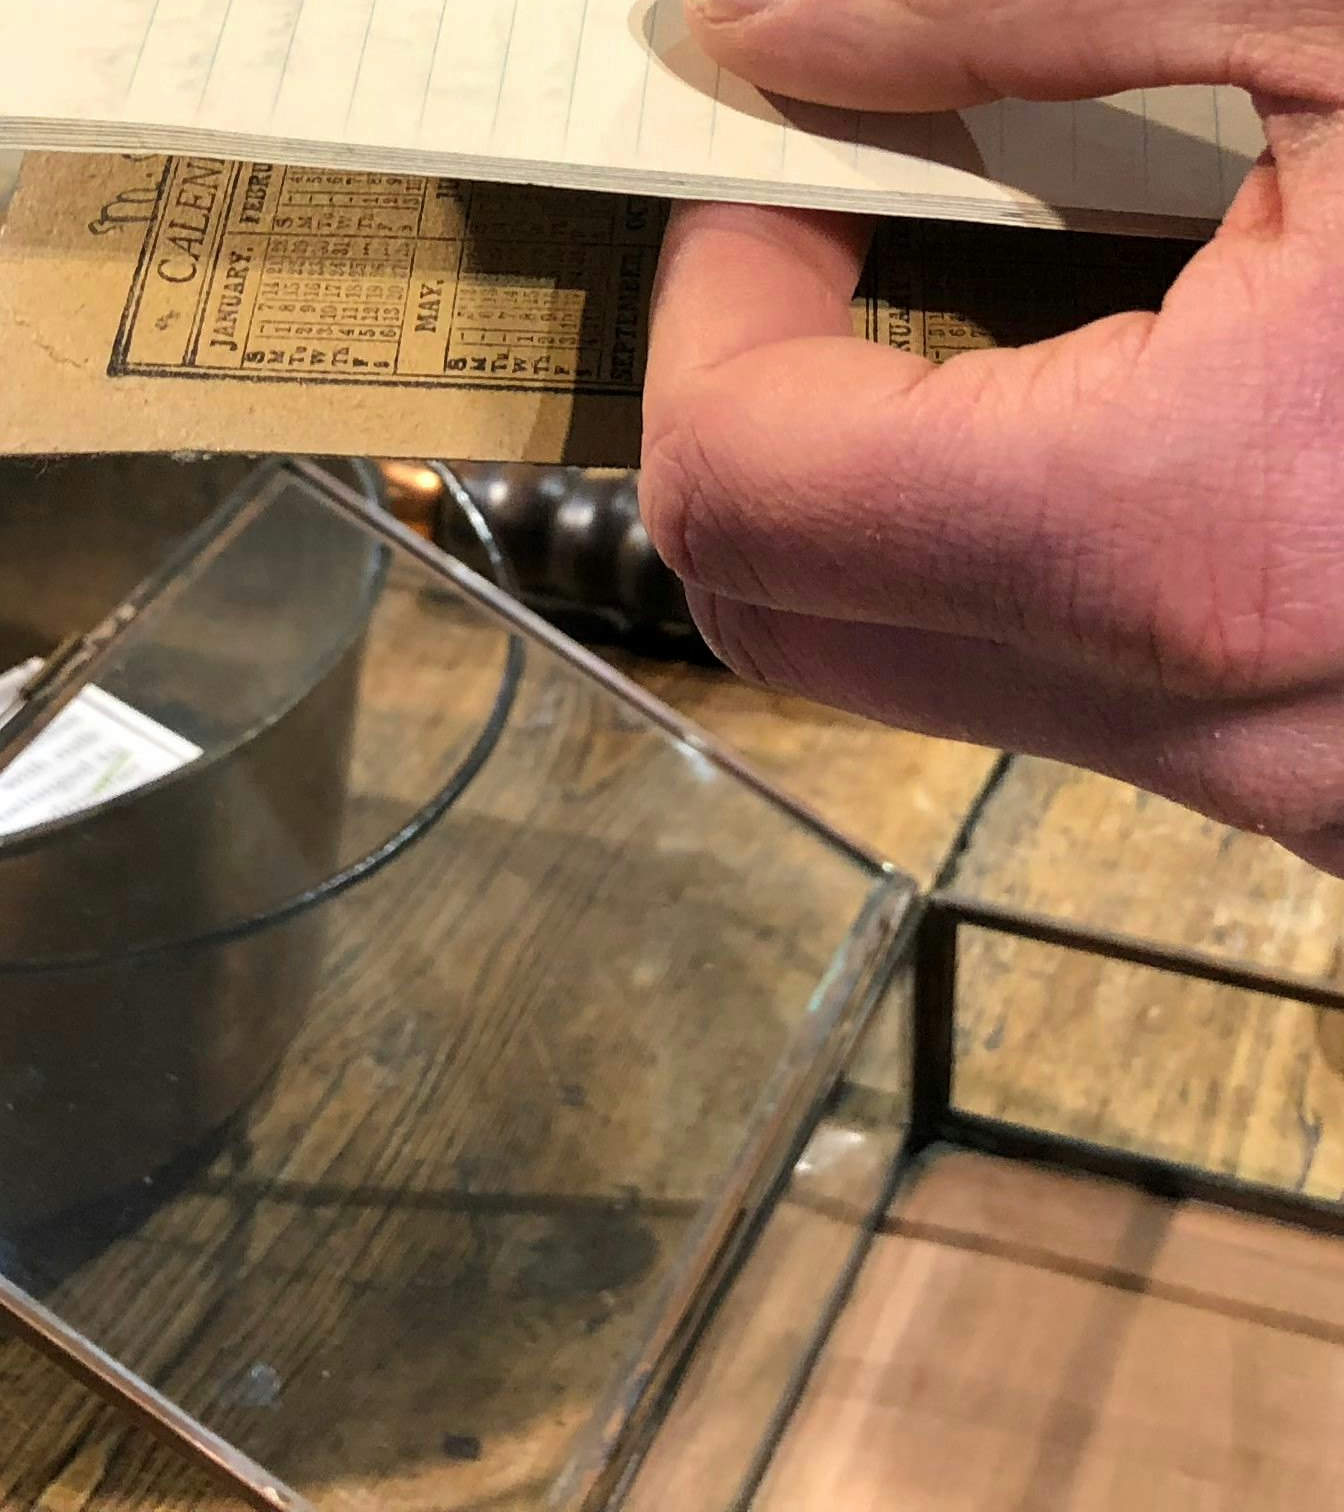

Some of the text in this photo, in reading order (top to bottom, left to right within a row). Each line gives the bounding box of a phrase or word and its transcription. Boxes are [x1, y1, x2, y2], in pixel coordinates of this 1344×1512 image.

[154, 157, 225, 282] CALEN
[209, 247, 255, 350] JANUARY.
[414, 279, 444, 332] MAY.
